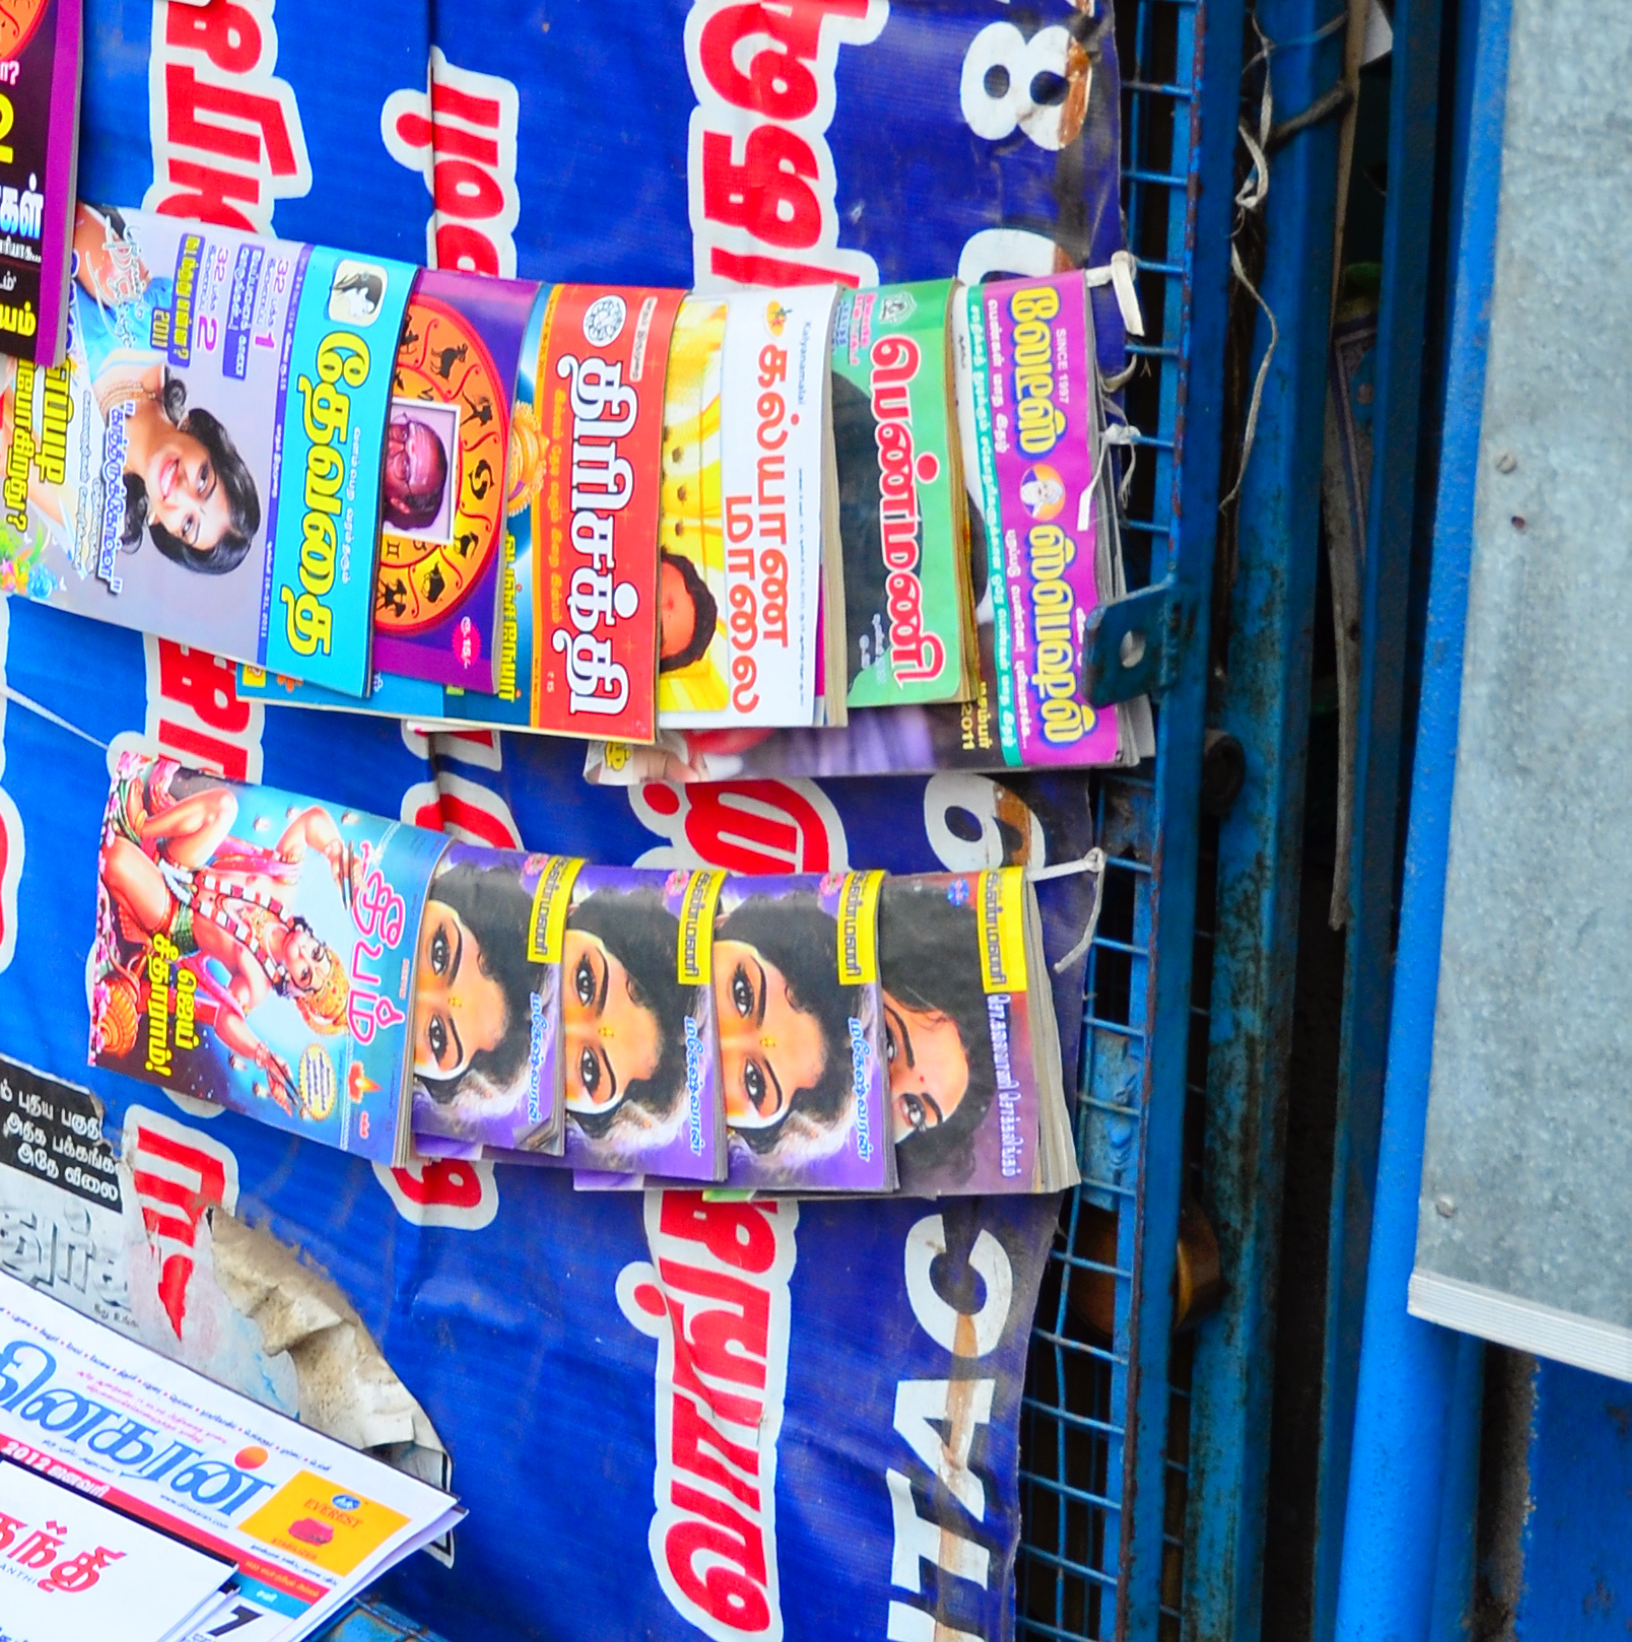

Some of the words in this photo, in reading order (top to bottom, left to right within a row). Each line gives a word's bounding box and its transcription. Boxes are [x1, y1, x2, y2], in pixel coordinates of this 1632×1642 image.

[197, 318, 218, 352] 2
[1010, 286, 1064, 456] லேடீஸ்
[1055, 328, 1067, 369] SINCE
[1058, 373, 1069, 405] 1997
[282, 331, 370, 656] தேவதை
[552, 354, 640, 716] திரிசக்தி
[757, 343, 801, 648] கல்யாண
[871, 334, 944, 689] பெண்மணி
[724, 494, 761, 715] மாலை
[1030, 524, 1097, 746] ஸ்பெஷல்
[143, 934, 180, 1077] சீதாராம்!
[172, 969, 197, 1051] ஜெய்
[0, 1439, 53, 1477] 2012
[304, 1497, 364, 1531] EVEREST
[206, 1604, 264, 1638] 7
